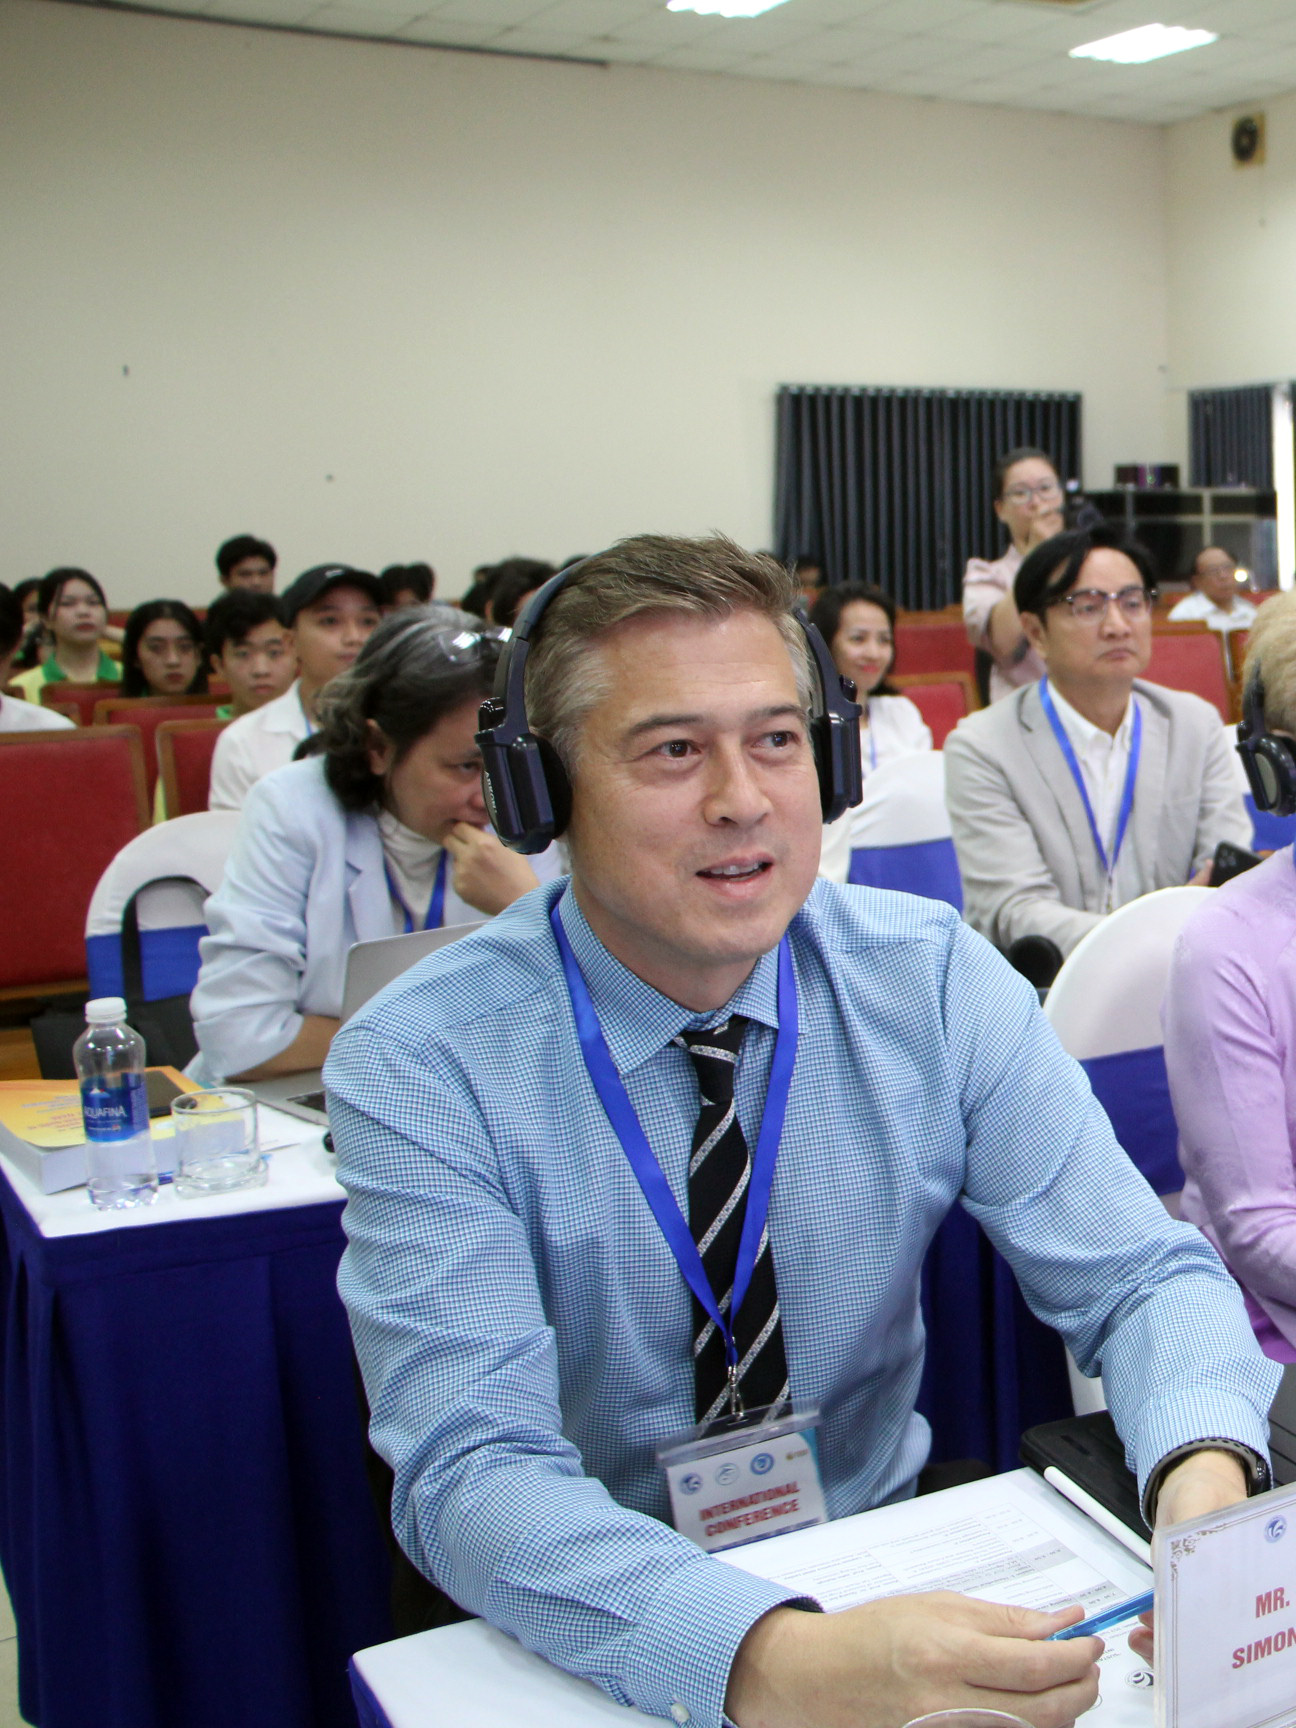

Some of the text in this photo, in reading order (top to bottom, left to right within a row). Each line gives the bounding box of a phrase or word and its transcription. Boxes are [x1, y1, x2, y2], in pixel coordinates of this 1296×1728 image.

[699, 1481, 800, 1521] INTERNATIONAL
[705, 1498, 800, 1536] CONFERENCE
[1255, 1586, 1290, 1618] MR.
